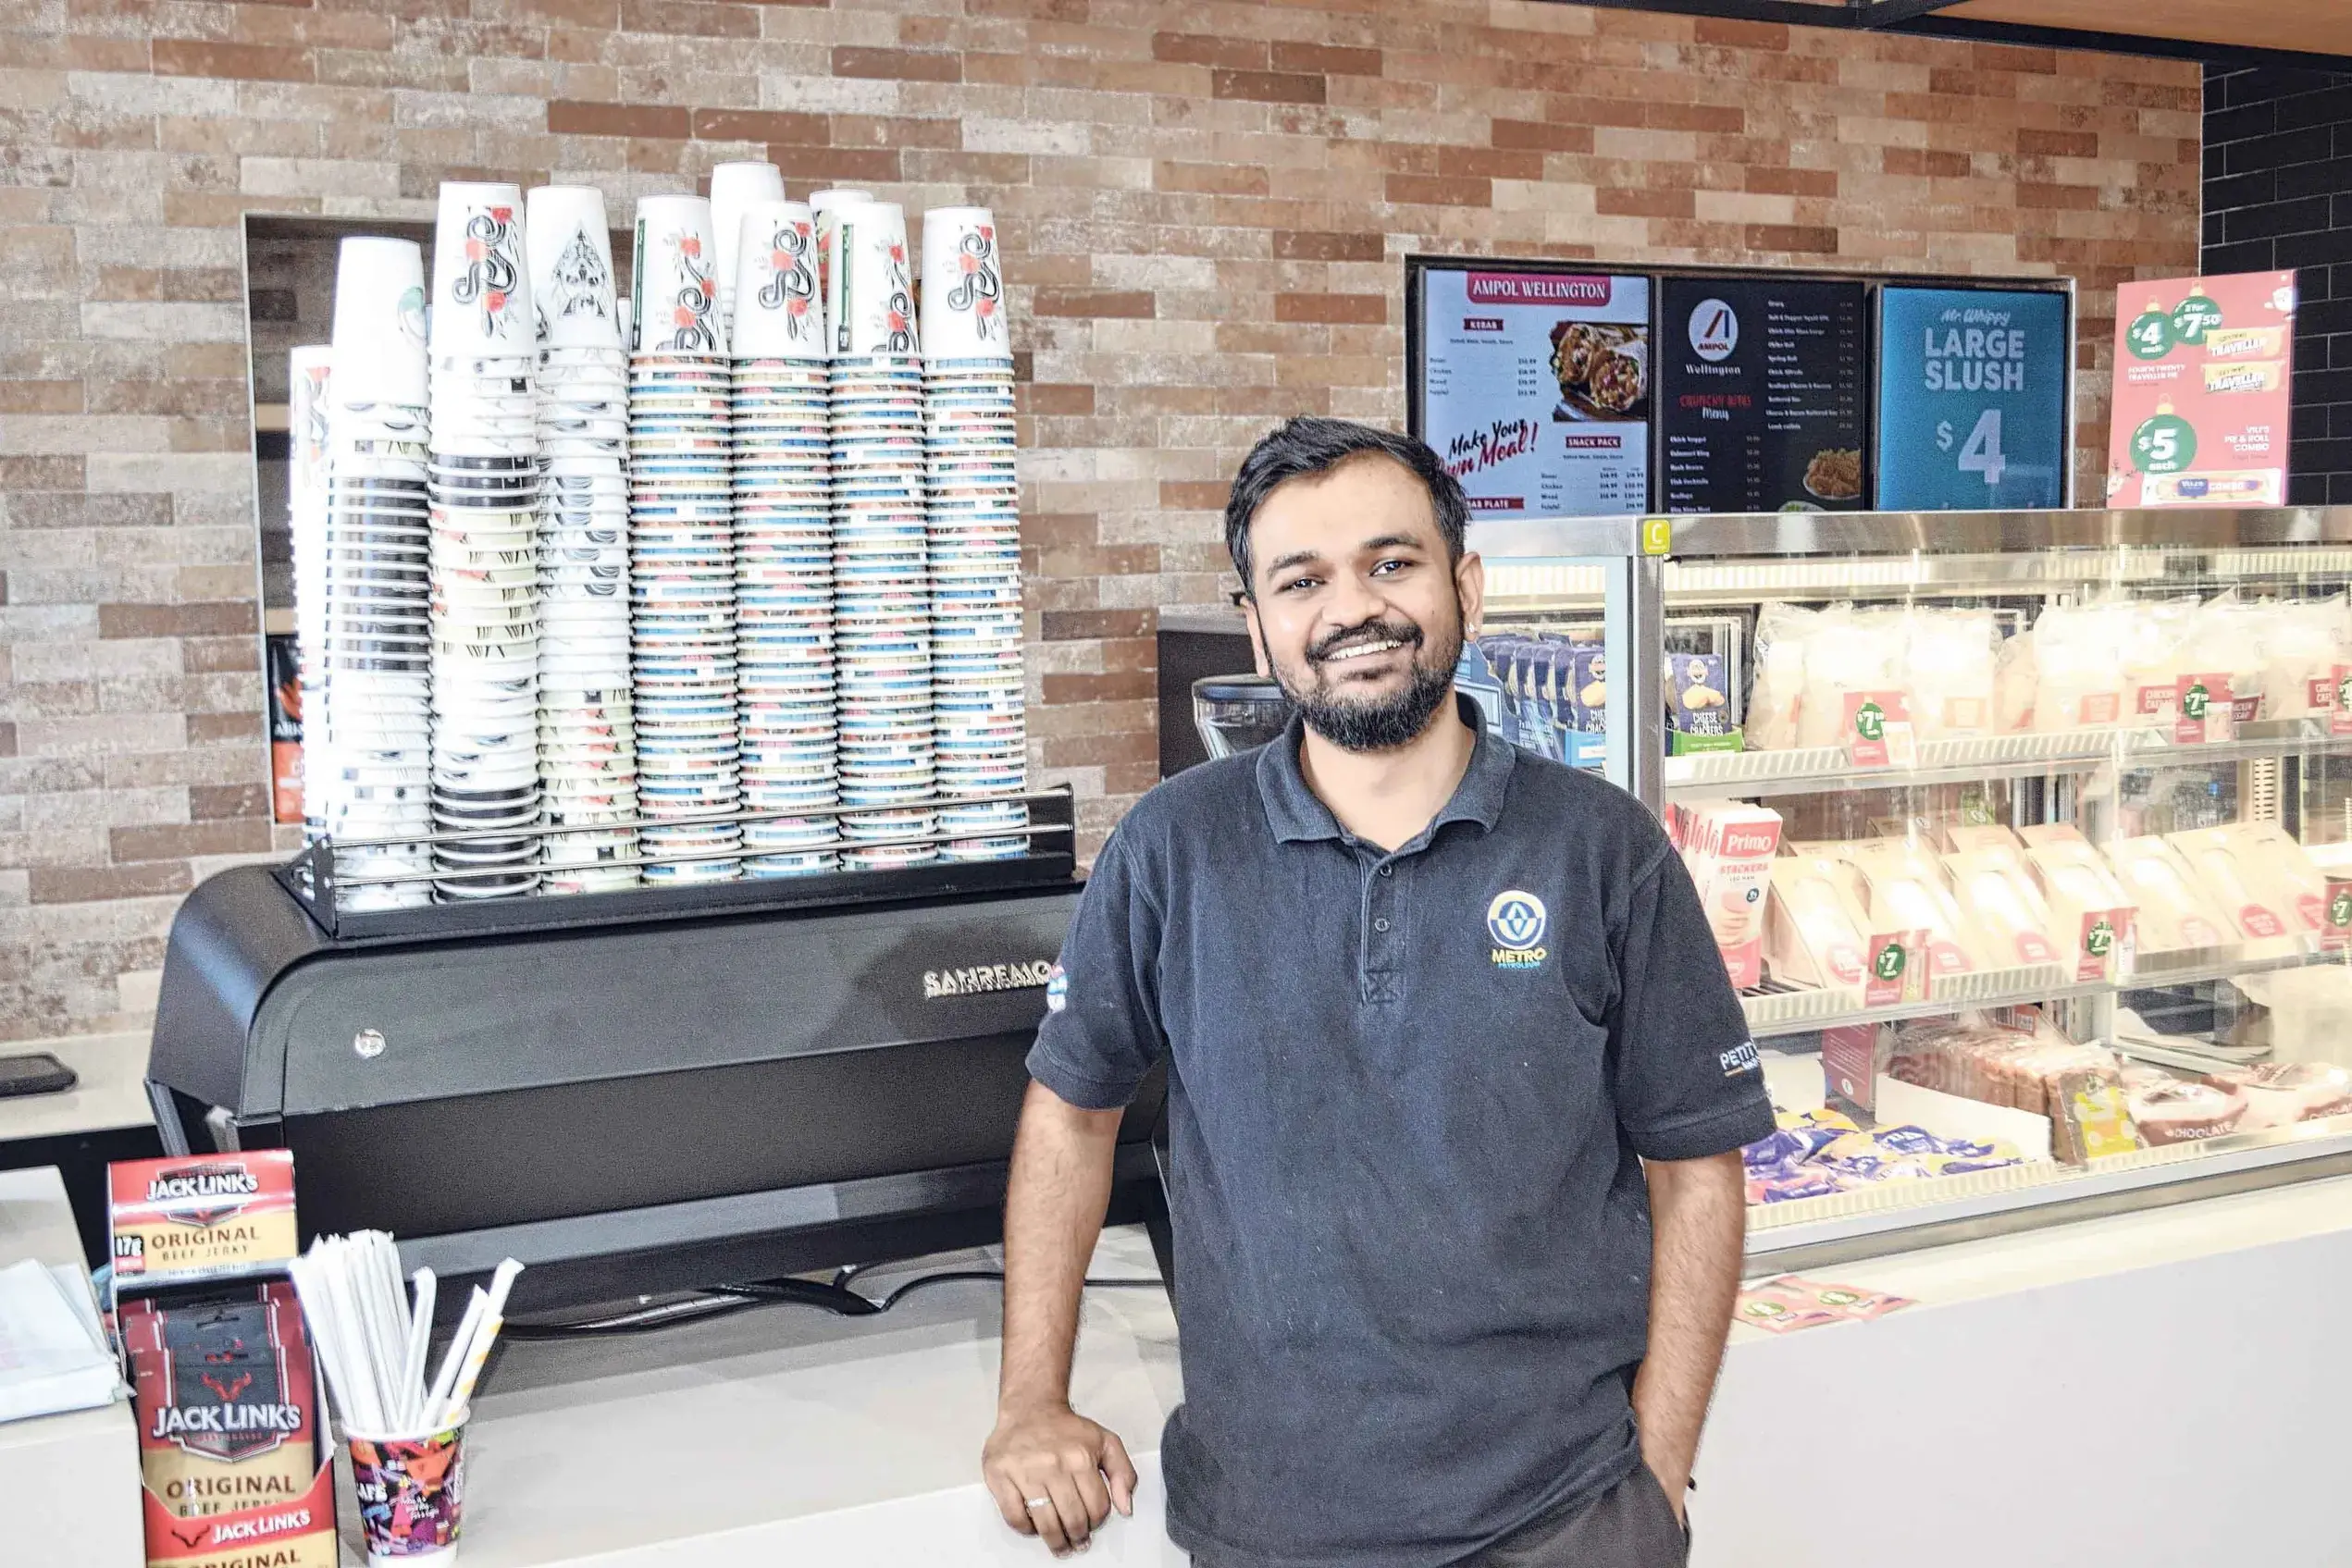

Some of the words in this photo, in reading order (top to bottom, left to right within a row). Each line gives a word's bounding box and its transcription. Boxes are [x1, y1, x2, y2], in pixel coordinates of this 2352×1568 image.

[1472, 279, 1518, 297] AMPOL
[1521, 280, 1606, 300] WELLINGTON
[1962, 308, 2012, 327] Whippy
[1925, 327, 2025, 359] LARGE
[2131, 321, 2161, 346] $4
[1698, 342, 1729, 351] AMPOL
[1685, 364, 1741, 377] Wellington
[1925, 360, 2024, 392] SLUSH
[1448, 429, 1488, 460] Make
[1492, 418, 1526, 439] Your
[1567, 438, 1595, 447] SNACK
[1597, 438, 1620, 447] PACK
[2136, 428, 2179, 461] $5
[2234, 443, 2270, 452] COMBO
[1445, 458, 1475, 477] wn
[1484, 499, 1509, 509] PLATE
[1692, 711, 1718, 724] CHEESE
[1726, 833, 1773, 854] Primo
[1492, 947, 1547, 964] METRO
[145, 1179, 197, 1203] JACK
[152, 1227, 260, 1250] ORIGINAL
[162, 1250, 195, 1262] BEEF
[206, 1244, 248, 1258] JERKY
[153, 1405, 224, 1438] JACK
[166, 1475, 296, 1500] ORIGINAL
[212, 1520, 257, 1545] JACK
